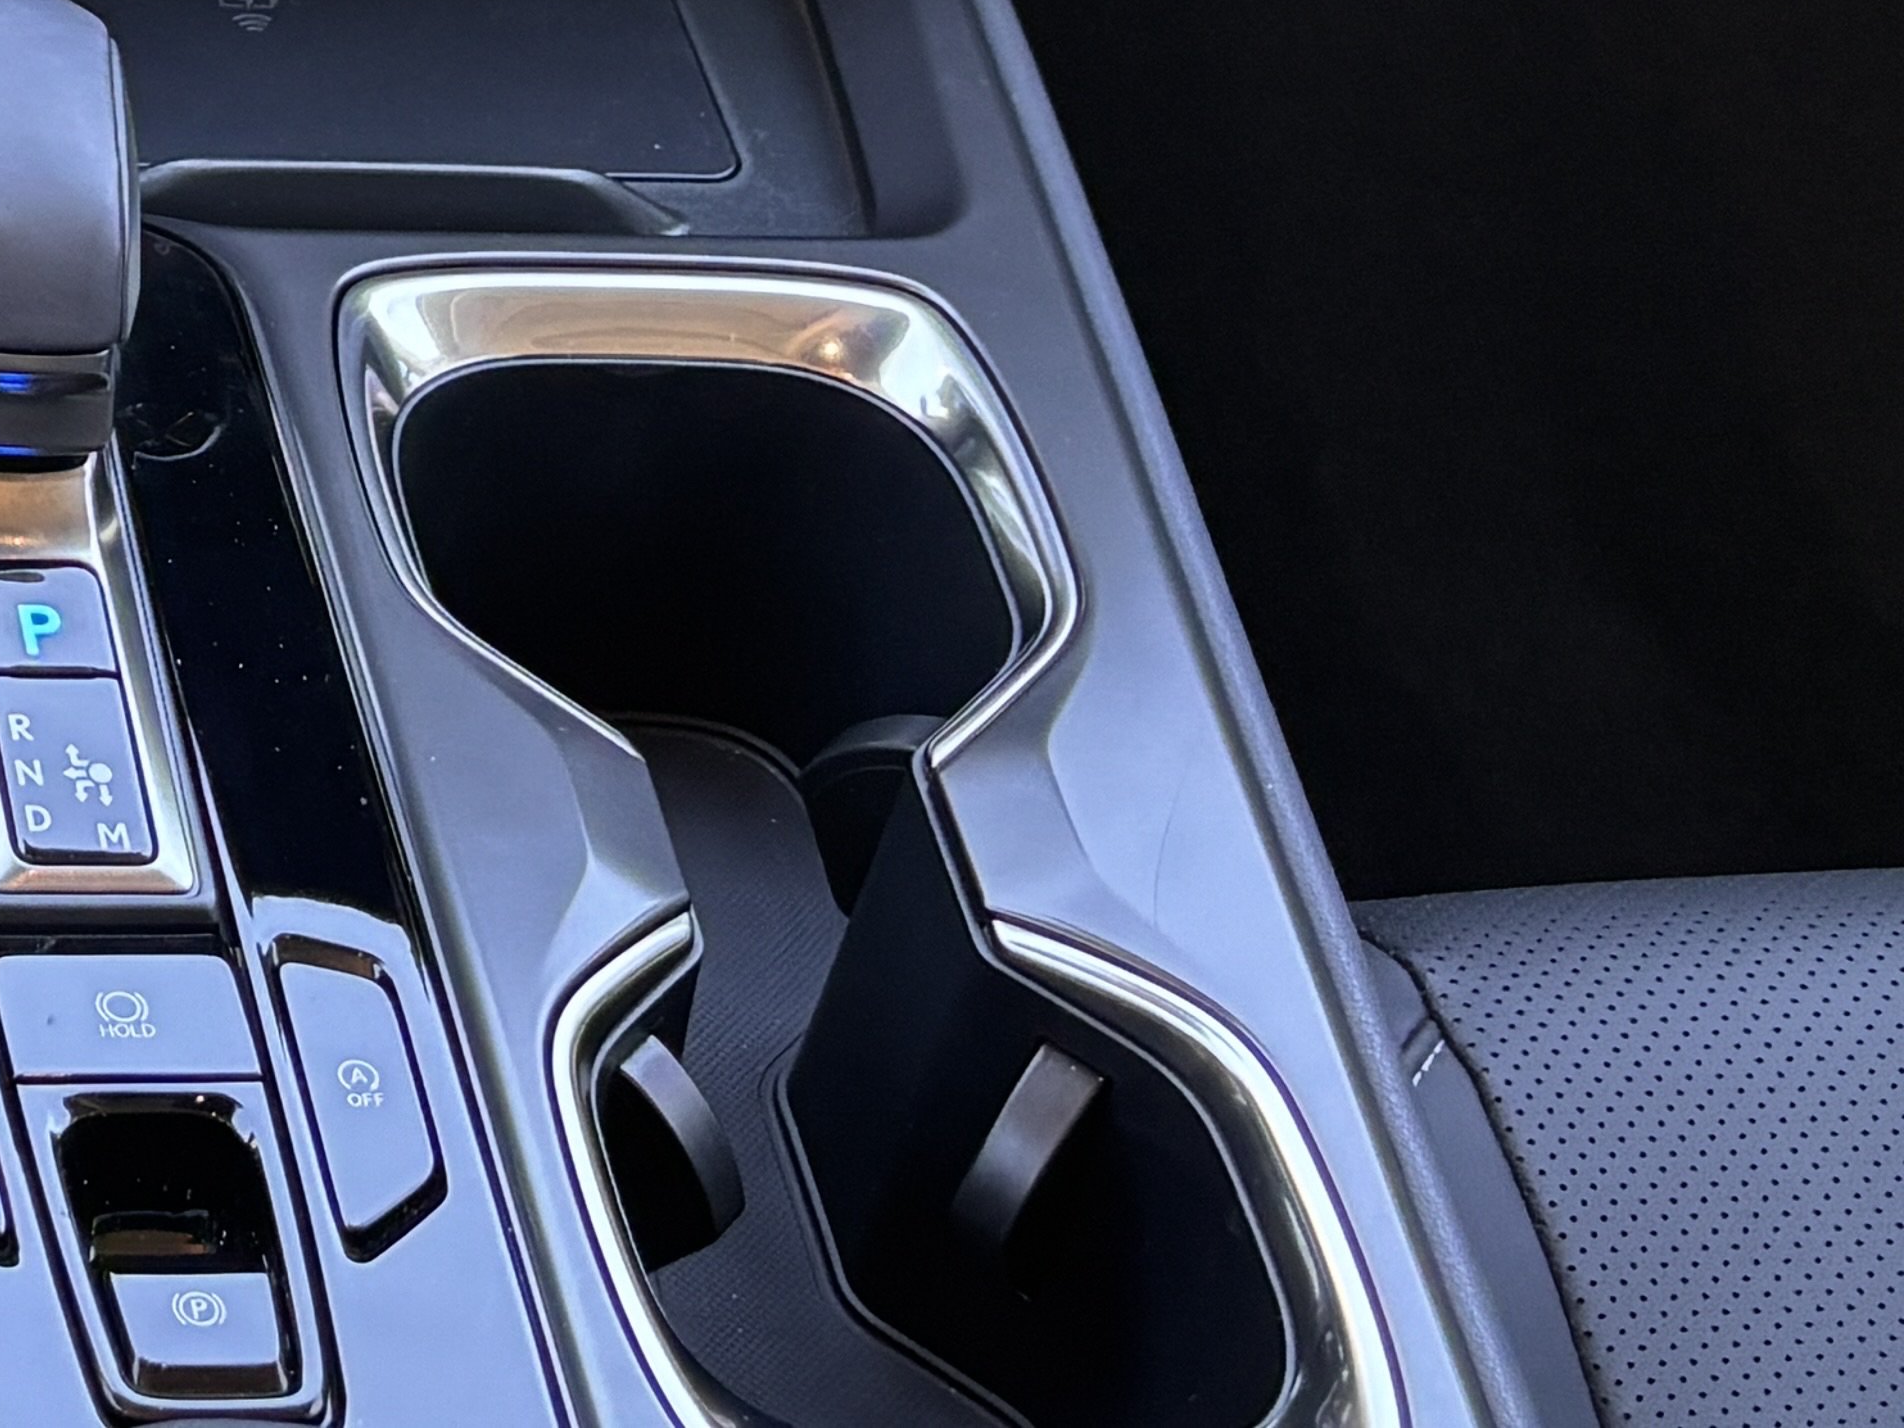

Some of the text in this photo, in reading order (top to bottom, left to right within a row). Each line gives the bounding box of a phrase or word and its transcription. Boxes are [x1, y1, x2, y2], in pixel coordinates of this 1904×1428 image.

[16, 603, 62, 656] P
[8, 713, 34, 741] R
[14, 759, 44, 786] N
[25, 804, 52, 832] D
[97, 822, 131, 851] M
[99, 1023, 156, 1039] HOLD
[347, 1091, 385, 1106] OFF
